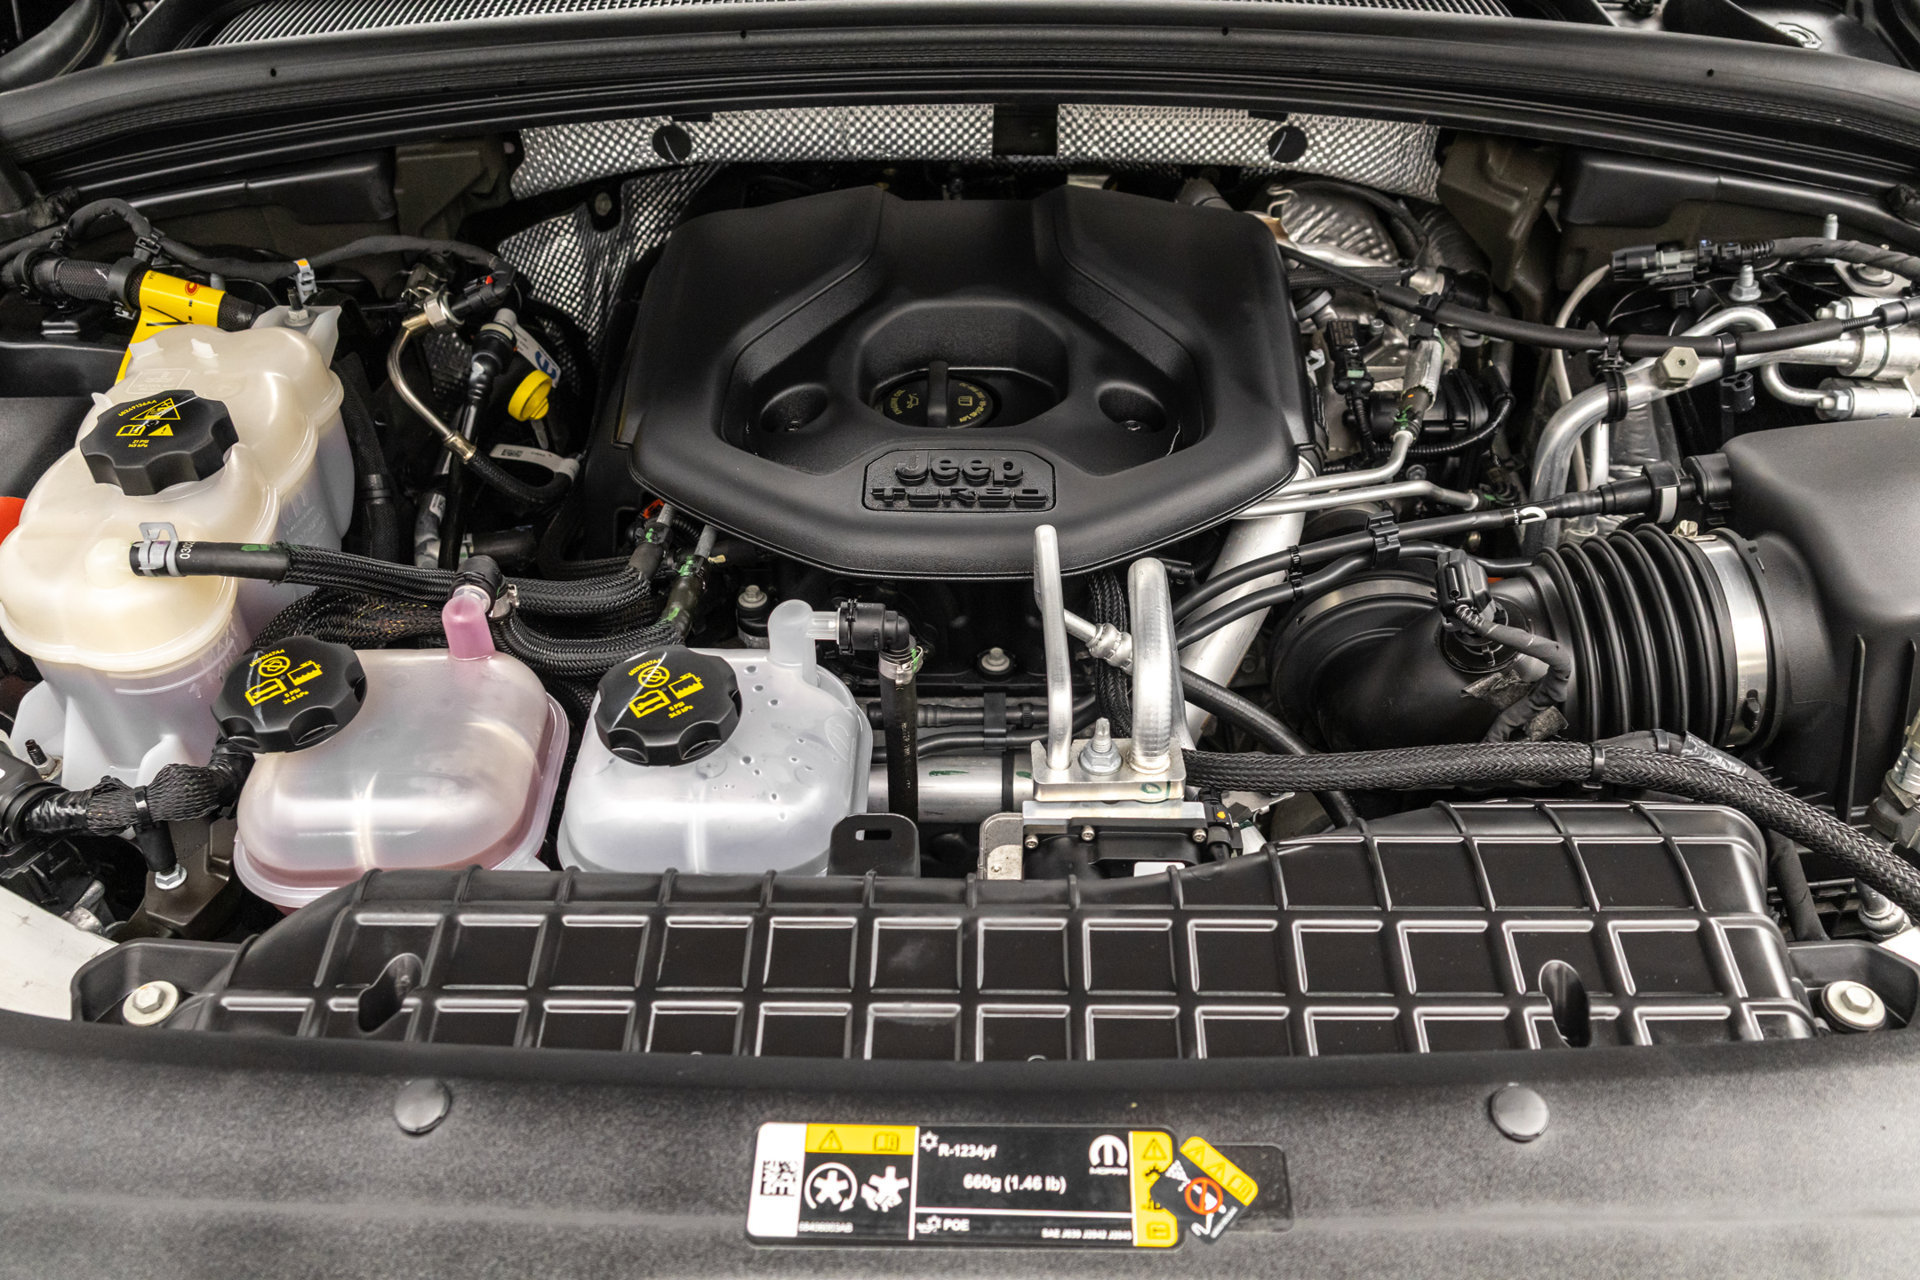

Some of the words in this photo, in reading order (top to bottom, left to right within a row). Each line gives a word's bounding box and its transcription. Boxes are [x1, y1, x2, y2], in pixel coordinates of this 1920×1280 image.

[895, 451, 1024, 488] Jeep
[938, 1143, 998, 1161] R-1234yf
[963, 1173, 1003, 1193] 660g
[1004, 1174, 1043, 1193] (1.46
[1045, 1175, 1068, 1195] lb)
[943, 1218, 970, 1231] POE
